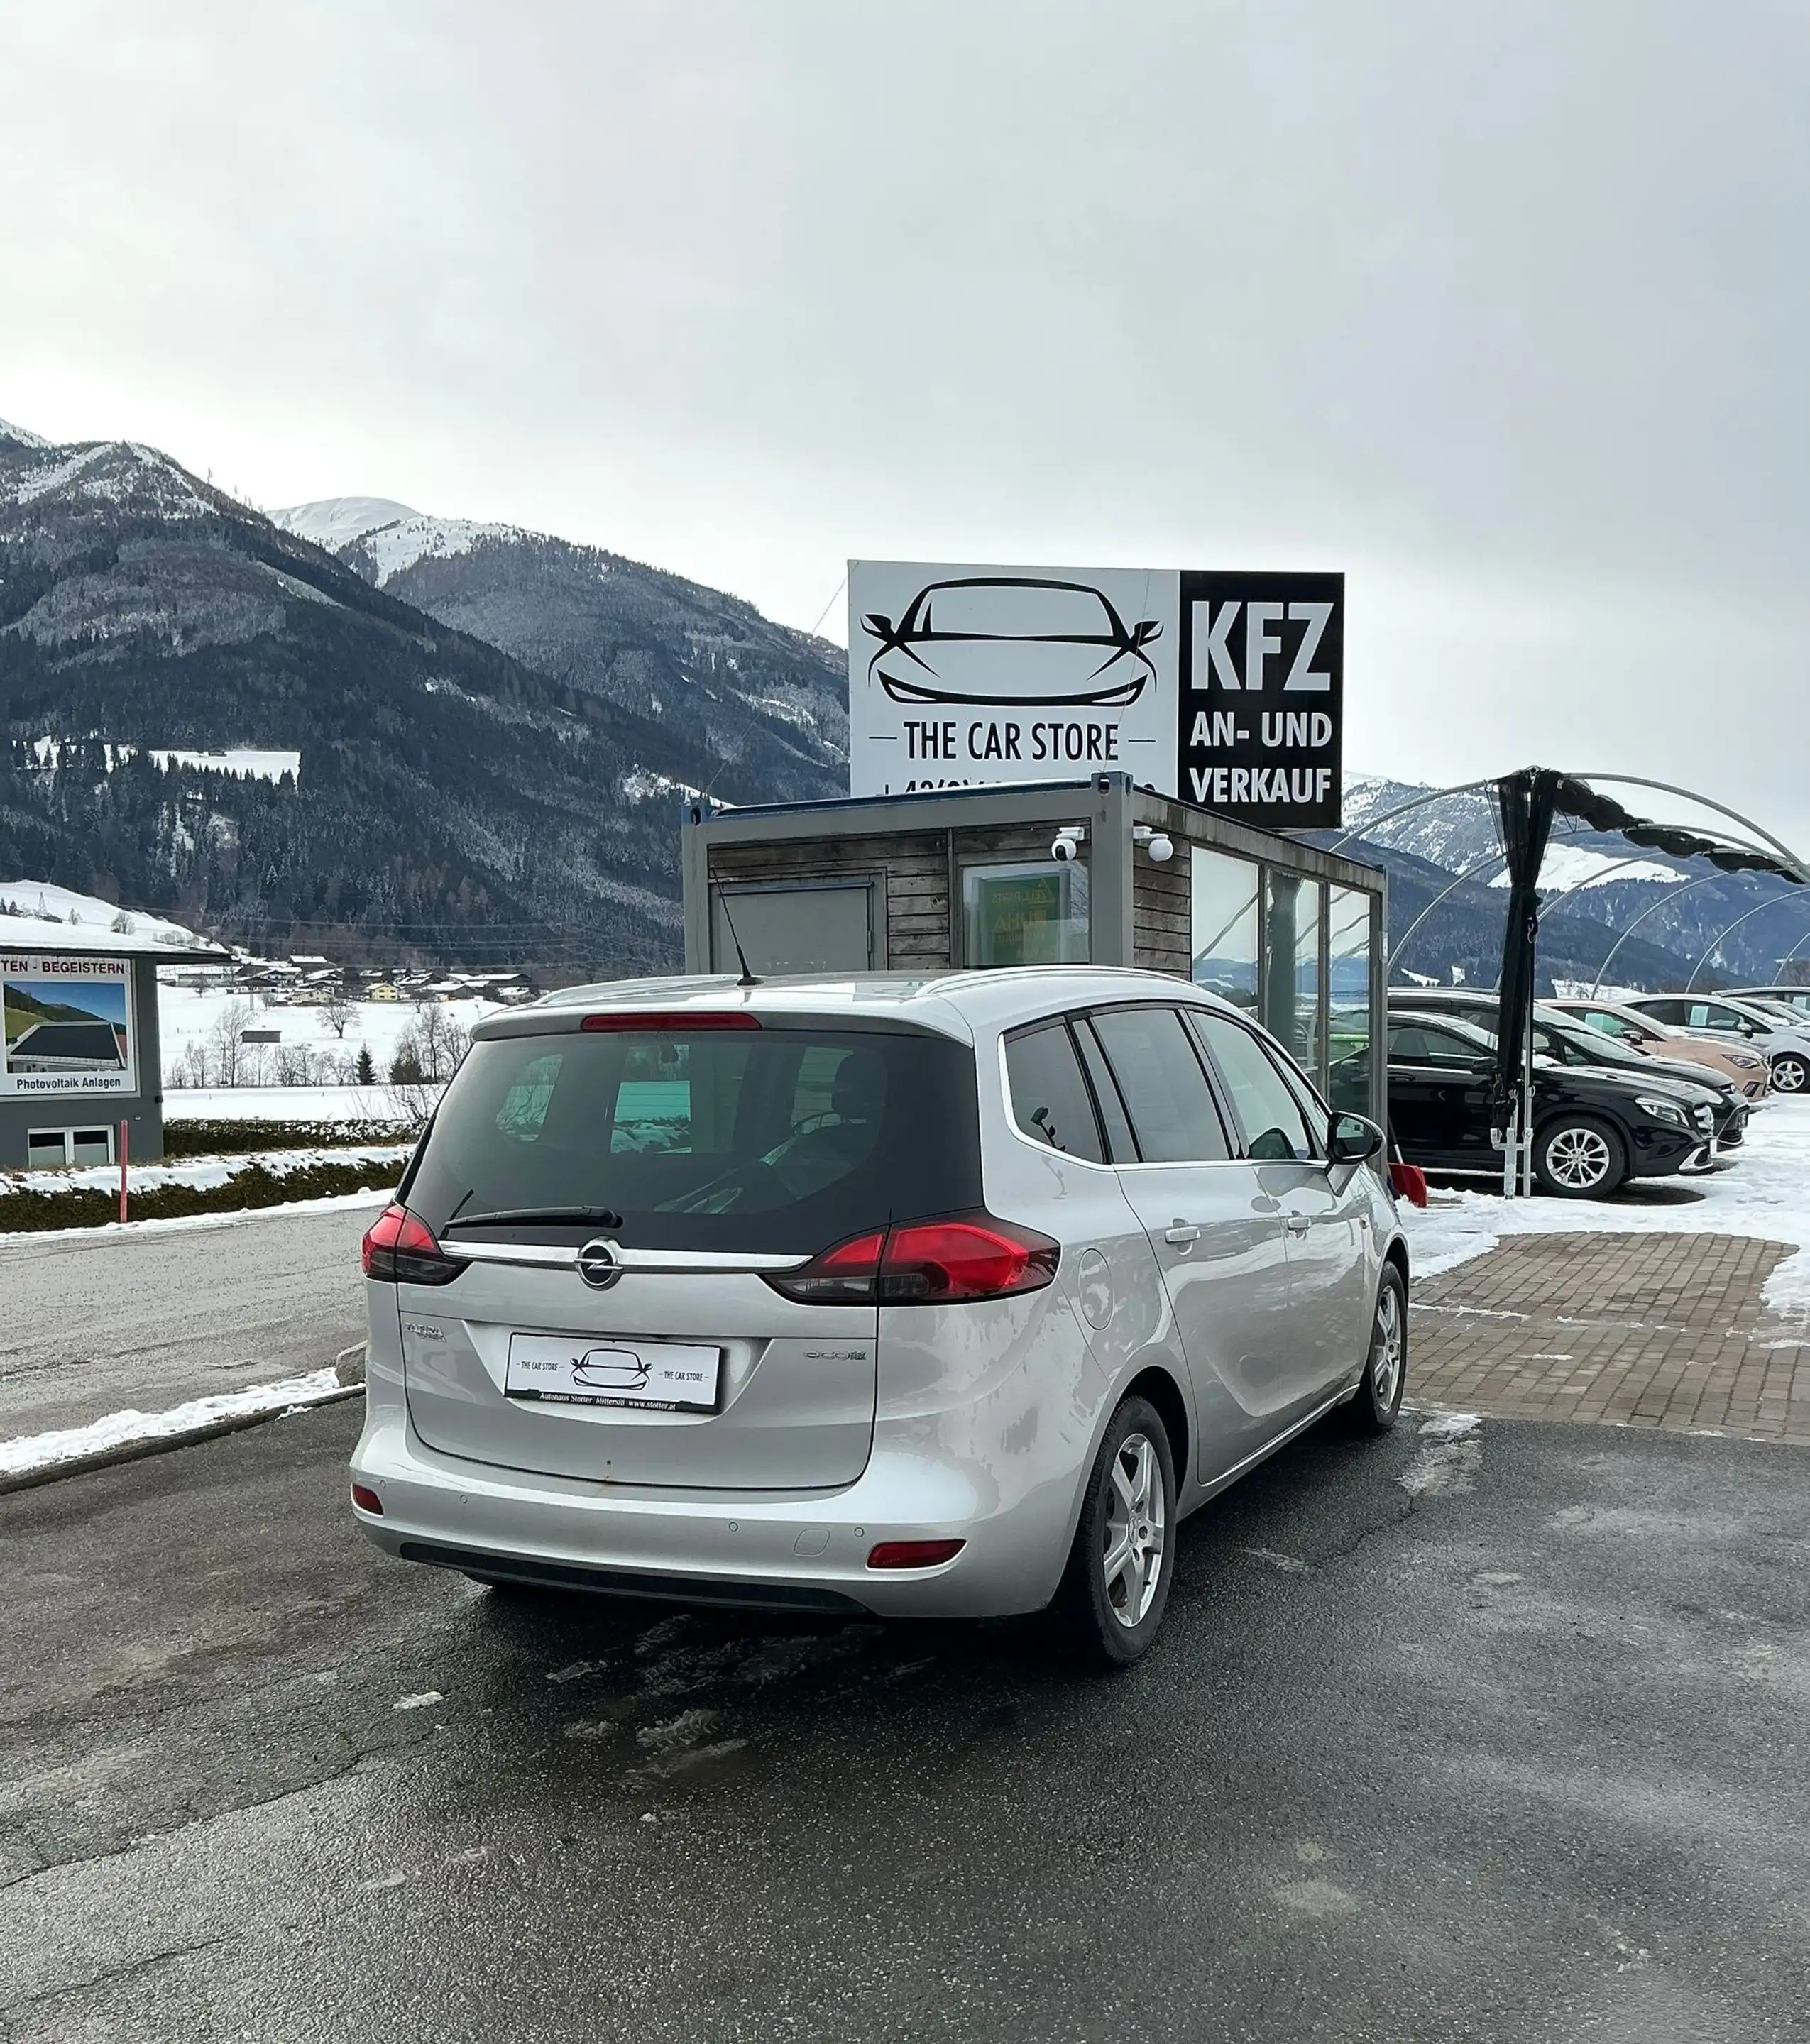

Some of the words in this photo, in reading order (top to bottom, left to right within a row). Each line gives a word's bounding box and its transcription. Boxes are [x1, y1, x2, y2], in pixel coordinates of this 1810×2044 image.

[1191, 600, 1334, 691] KFZ
[1190, 711, 1249, 747] AN-
[1261, 711, 1332, 747] UND
[903, 721, 957, 759] THE
[967, 722, 1022, 760] CAR
[1031, 722, 1119, 761] STORE
[1189, 767, 1332, 803] VERKAUF
[42, 960, 125, 974] BEGEISTERN
[16, 1078, 79, 1090] Photovoltaik
[82, 1077, 121, 1089] Anlagen
[521, 1361, 531, 1369] THE
[532, 1361, 542, 1370] CAR
[542, 1362, 559, 1371] STORE
[664, 1370, 674, 1380] THE
[674, 1371, 686, 1380] CAR
[686, 1372, 703, 1382] STORE
[539, 1392, 569, 1401] Autohaus
